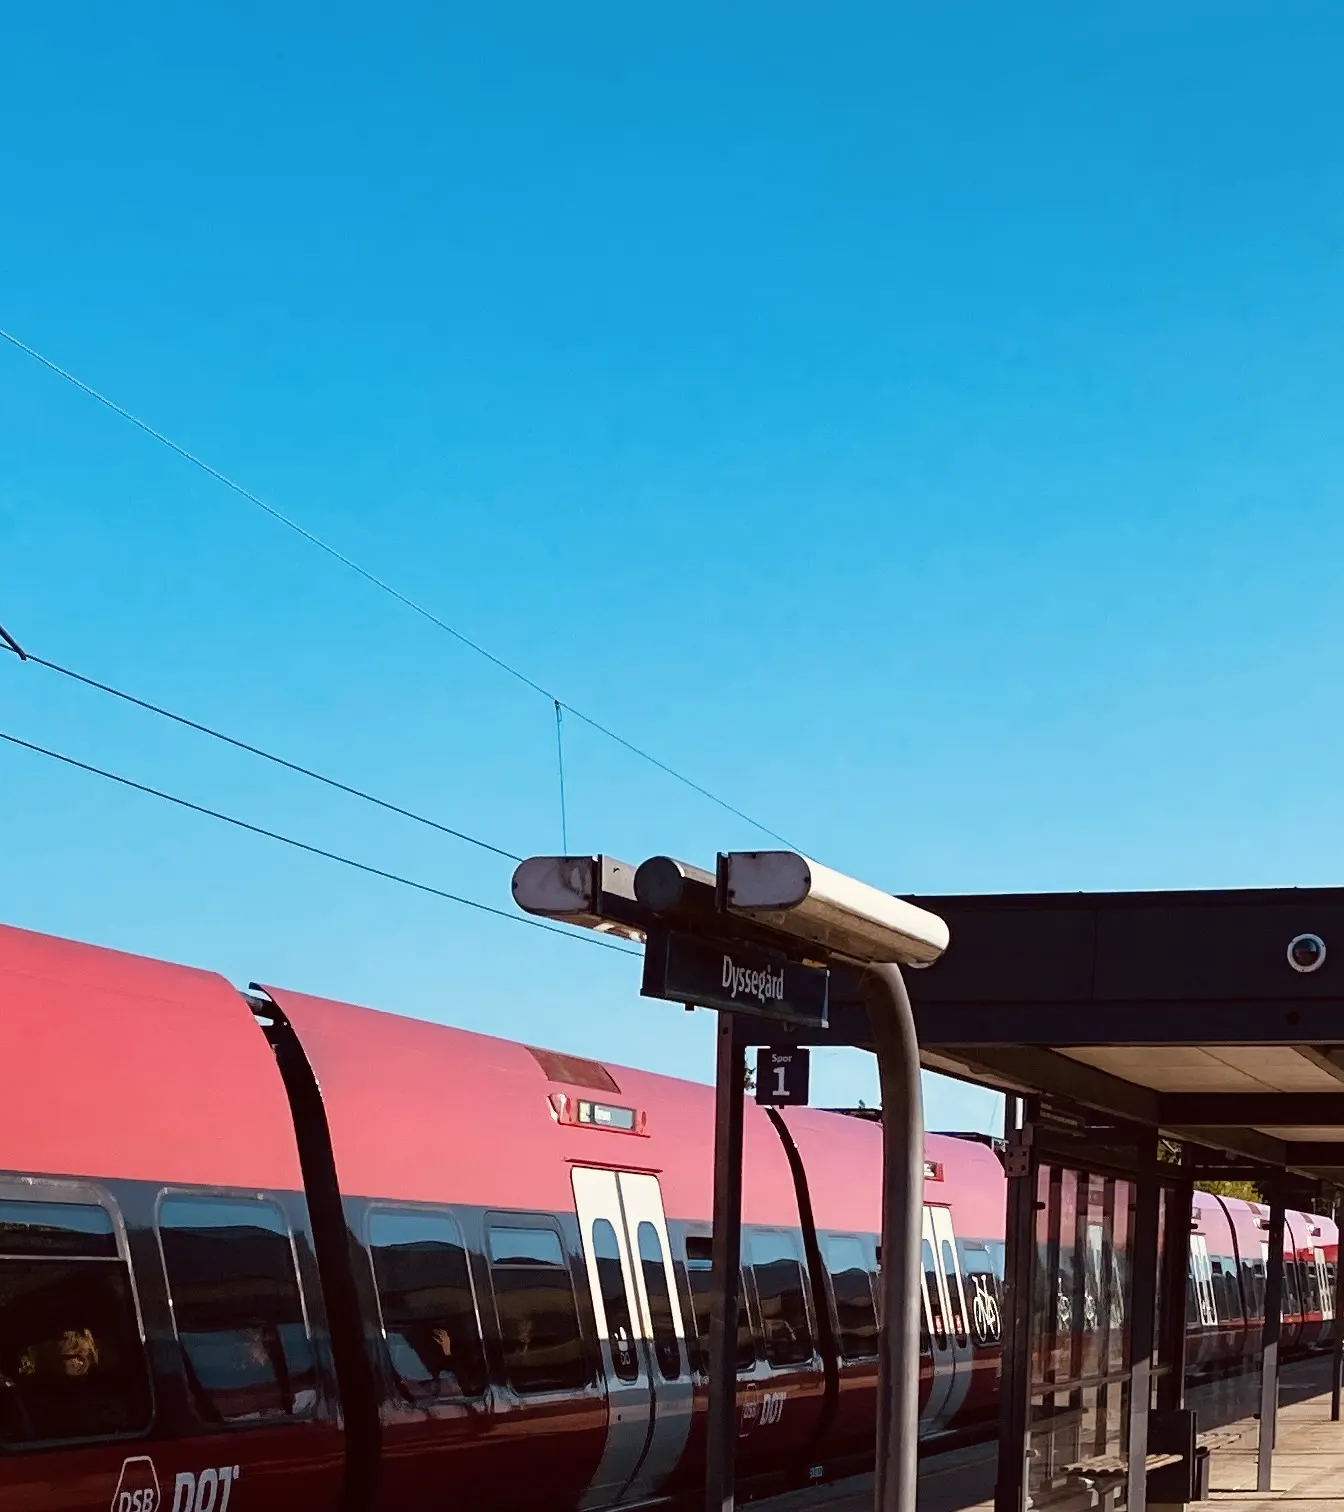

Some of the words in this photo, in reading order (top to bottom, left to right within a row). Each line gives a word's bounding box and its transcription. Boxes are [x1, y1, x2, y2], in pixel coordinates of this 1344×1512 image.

[722, 954, 785, 1004] Dyssegård
[771, 1053, 793, 1064] Spor
[772, 1066, 791, 1096] 1
